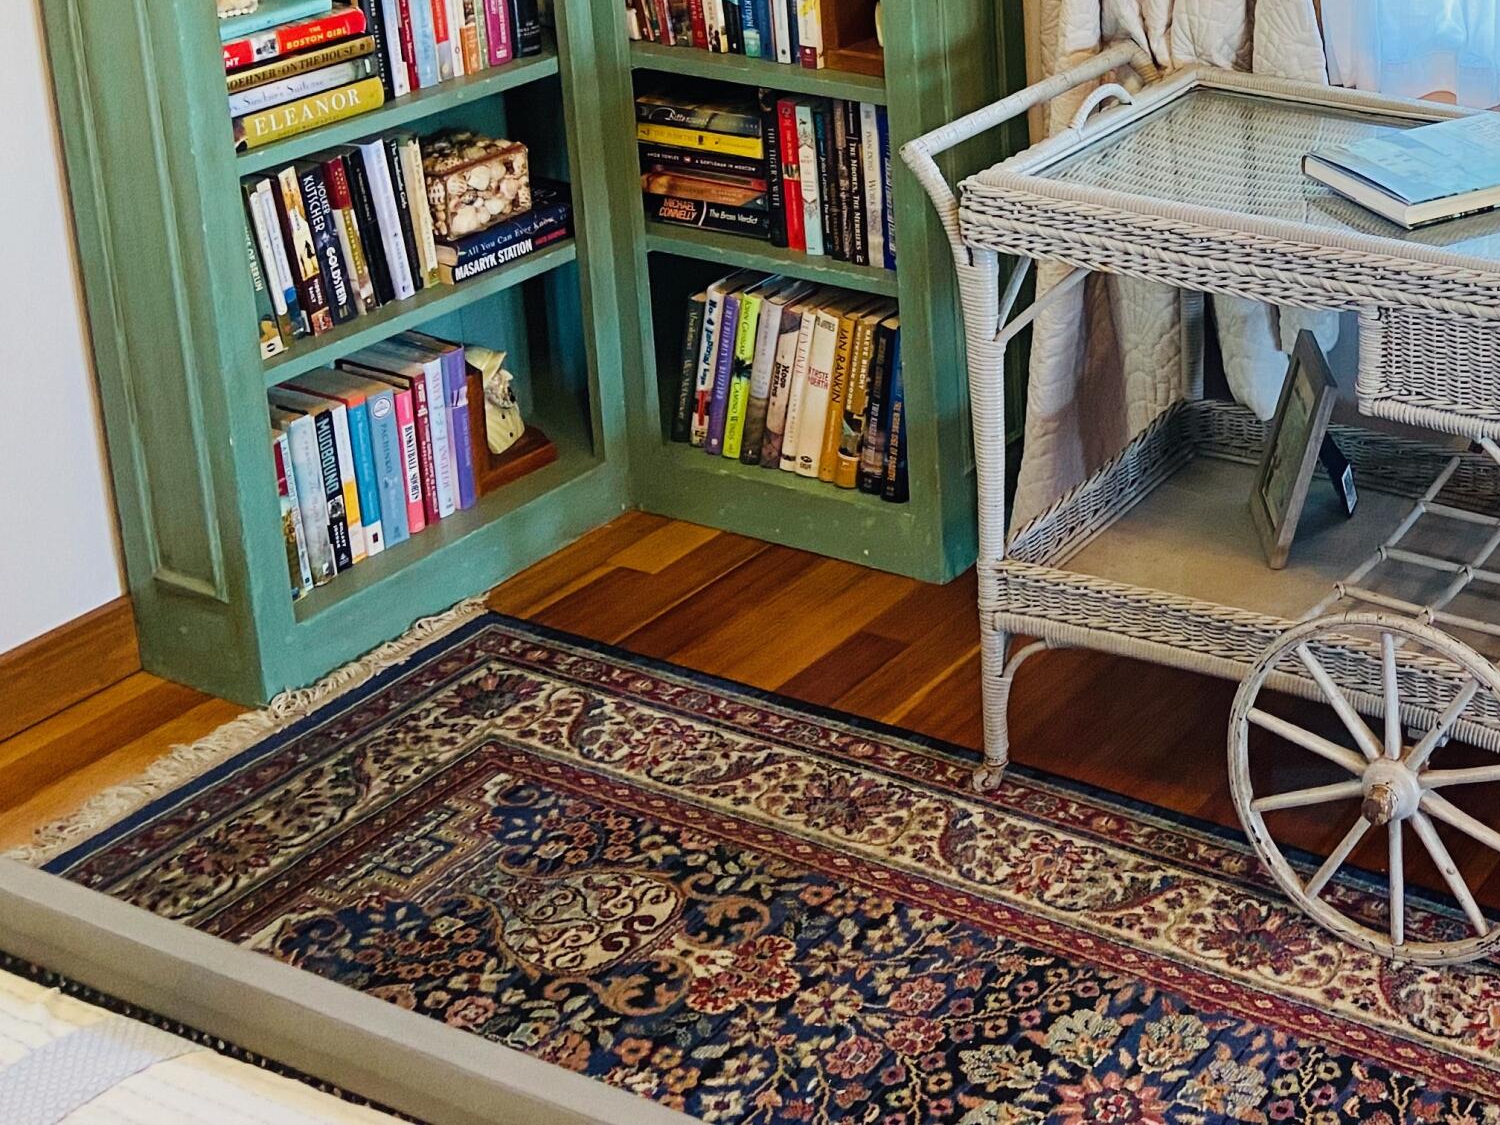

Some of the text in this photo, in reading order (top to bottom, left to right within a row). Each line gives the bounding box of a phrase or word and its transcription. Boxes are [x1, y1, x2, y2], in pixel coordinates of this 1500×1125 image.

[286, 26, 347, 49] BOSTON GIRL
[226, 45, 354, 90] OEHNER ON THE HOUSE
[252, 87, 361, 136] ELEANOR
[768, 148, 777, 182] TIGER'S
[299, 174, 328, 233] KUTSCHER
[314, 181, 332, 215] VOLKER
[658, 205, 697, 221] CONNELLY
[663, 198, 696, 211] MICHAEL
[708, 209, 757, 224] The Brass Verdict
[771, 185, 779, 207] WIFE
[452, 237, 534, 281] MASARYK STATION
[466, 245, 479, 256] All
[480, 238, 496, 251] You
[495, 231, 512, 244] Can
[513, 223, 531, 237] Ever
[249, 261, 263, 291] BERLIN
[322, 245, 350, 305] GOLDSTEIN
[739, 300, 752, 355] JOHN GRISHAM
[838, 327, 848, 352] IAN
[831, 354, 846, 404] RANKIN
[728, 382, 742, 440] CAMINO WINDS
[314, 417, 341, 495] MUDBOUND
[379, 423, 393, 473] PACHINKO
[404, 424, 417, 470] BASKETBALL
